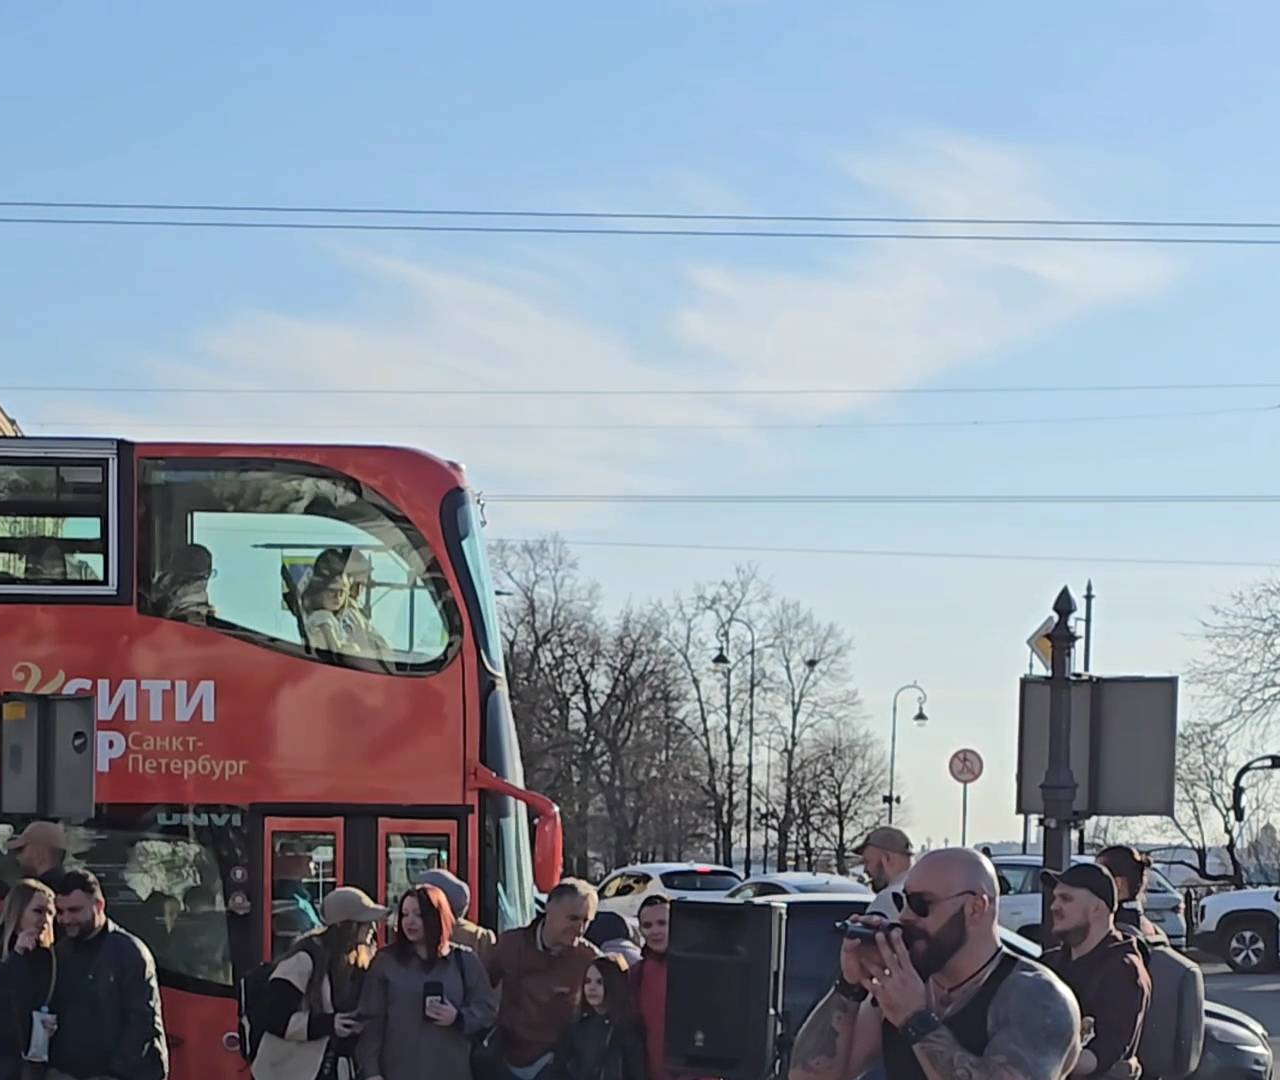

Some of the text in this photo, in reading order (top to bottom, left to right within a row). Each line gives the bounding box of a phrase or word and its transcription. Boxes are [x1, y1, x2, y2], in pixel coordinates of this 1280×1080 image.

[128, 731, 204, 752] Санкт-
[128, 754, 248, 781] Петербург
[156, 812, 242, 827] UNVI
